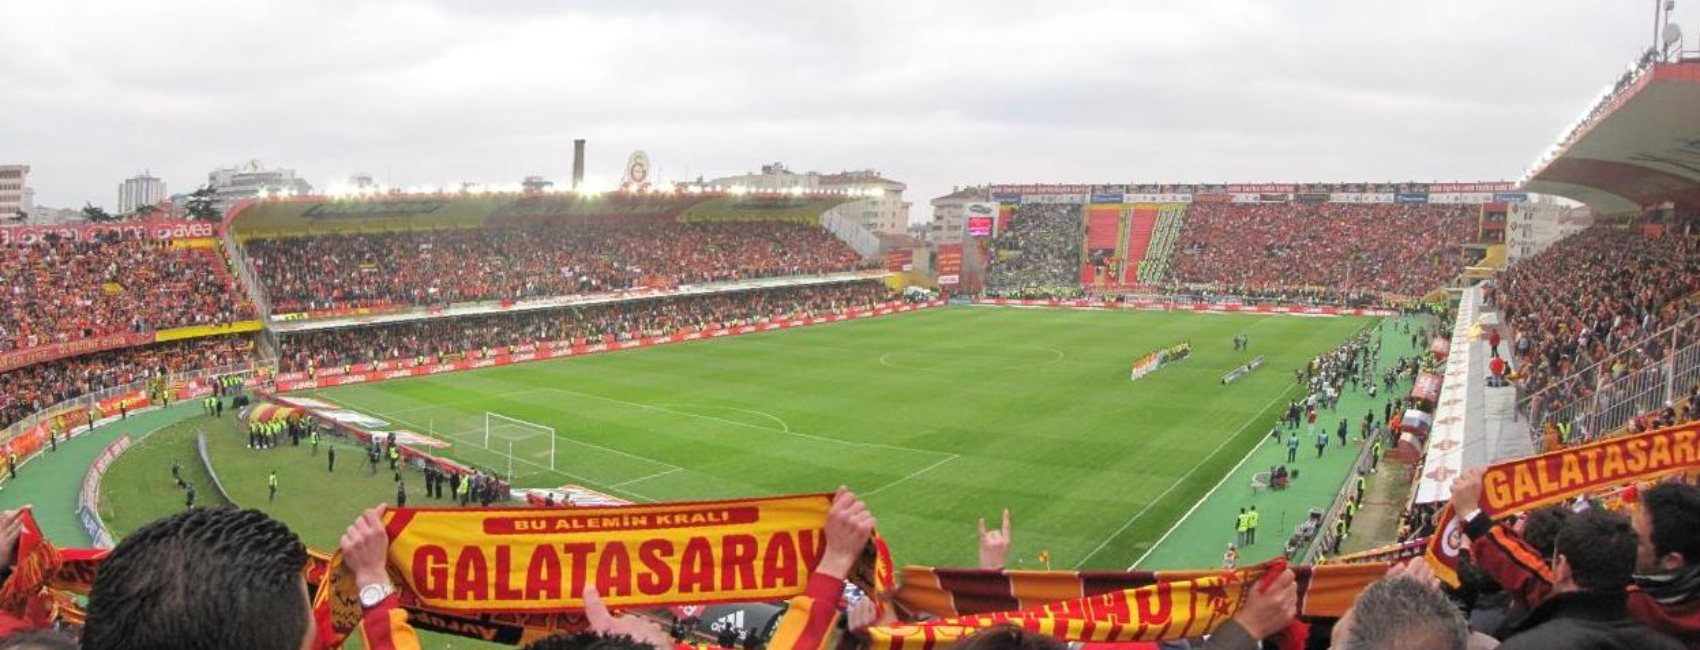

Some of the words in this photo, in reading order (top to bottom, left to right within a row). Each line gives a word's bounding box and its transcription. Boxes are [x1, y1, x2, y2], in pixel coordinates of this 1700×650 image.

[173, 223, 212, 237] avea
[1483, 430, 1700, 510] GALATASAR
[513, 519, 547, 531] BU
[555, 514, 647, 530] ALEMİN
[656, 511, 730, 526] KRALI
[412, 530, 827, 600] GALATASARAY
